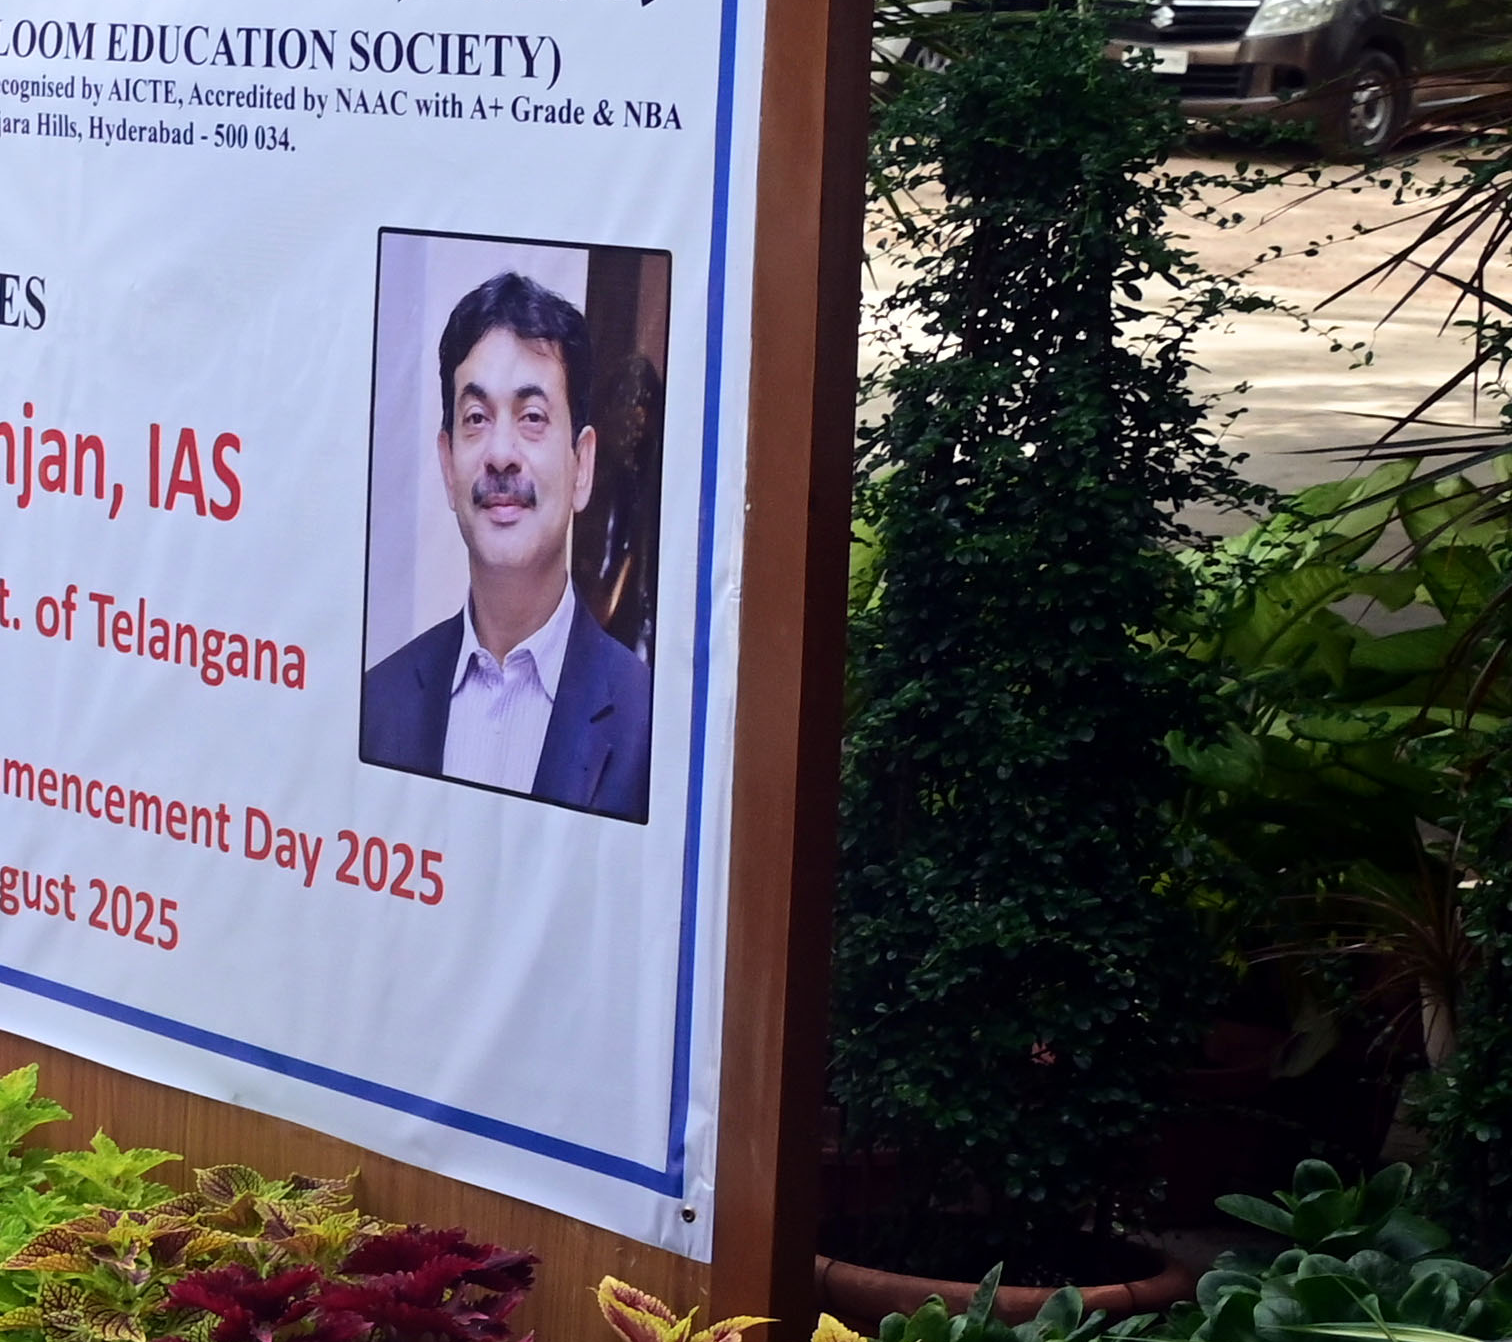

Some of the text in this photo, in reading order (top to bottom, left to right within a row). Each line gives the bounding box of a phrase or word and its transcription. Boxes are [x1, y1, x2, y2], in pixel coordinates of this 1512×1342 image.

[106, 24, 337, 70] EDUCATION
[350, 30, 561, 90] SOCIETY)
[37, 113, 82, 142] Hills,
[89, 116, 193, 146] Hyderabad
[214, 124, 248, 148] 500
[255, 125, 295, 151] 034.
[82, 76, 103, 101] by
[108, 78, 183, 109] AICTE,
[188, 83, 295, 110] Accredited
[304, 87, 328, 119] by
[336, 88, 407, 116] NAAC
[415, 92, 462, 118] with
[470, 95, 503, 119] A+
[511, 96, 584, 124] Grade
[593, 99, 614, 126] &
[624, 101, 682, 130] NBA
[149, 423, 241, 521] IAS
[36, 584, 77, 641] of
[89, 592, 305, 690] Telangana
[245, 807, 322, 887] Day
[336, 830, 443, 905] 2025
[89, 879, 178, 950] 2025
